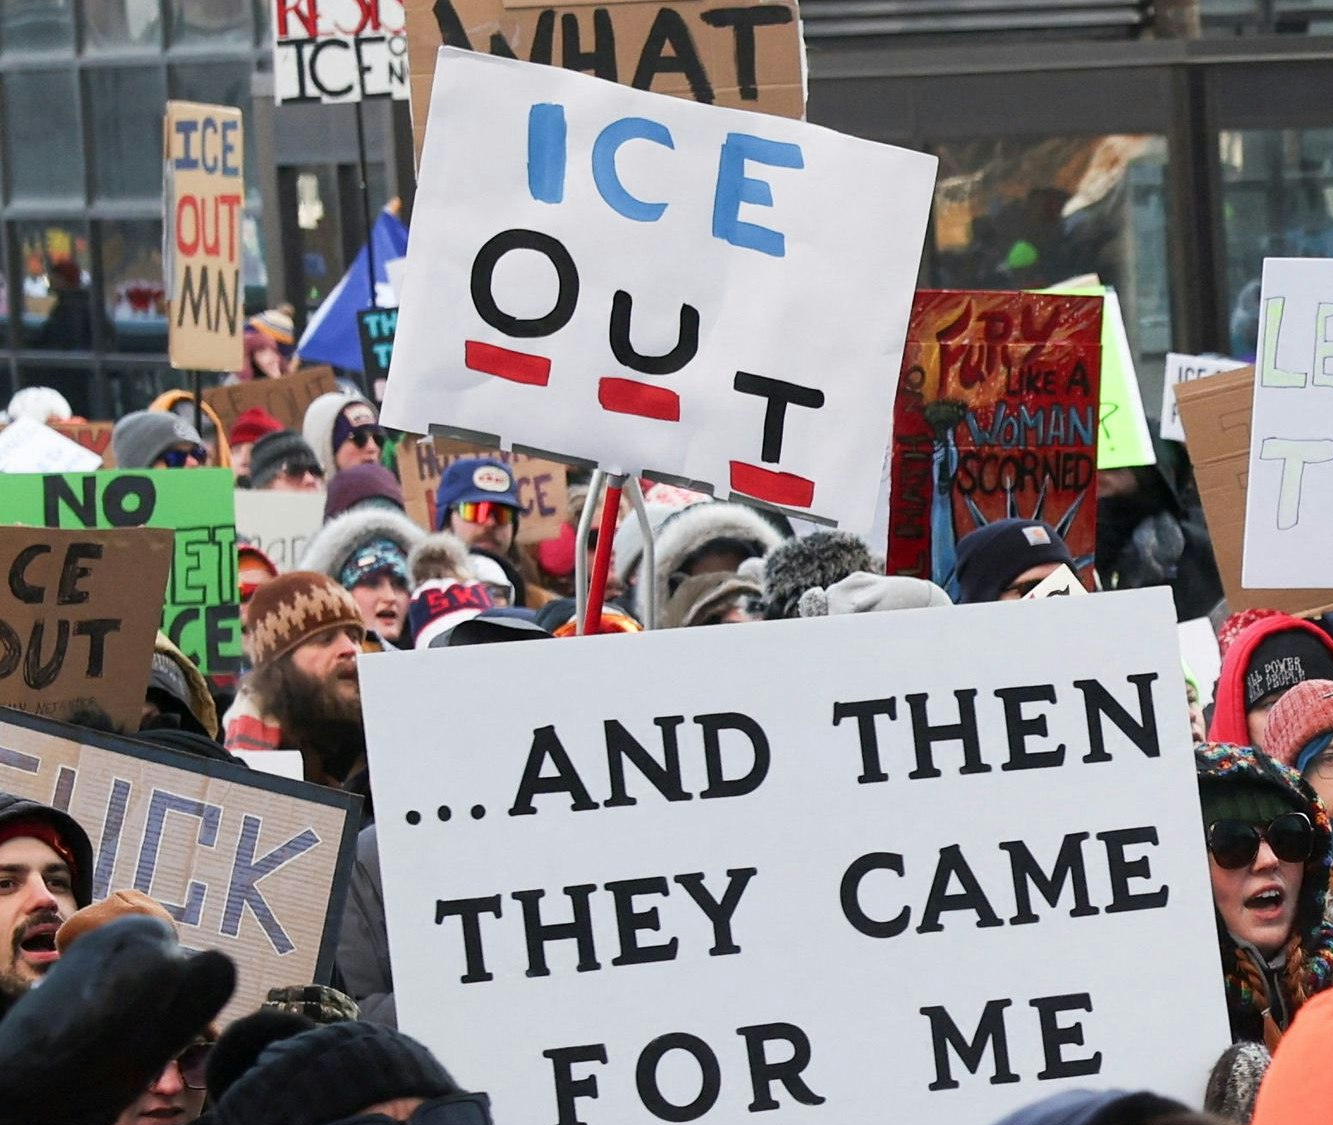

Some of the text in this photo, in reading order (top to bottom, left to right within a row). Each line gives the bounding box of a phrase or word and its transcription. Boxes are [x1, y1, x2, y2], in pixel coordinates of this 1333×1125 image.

[277, 36, 392, 104] ICE
[432, 0, 793, 102] WHAT
[175, 116, 239, 177] ICE
[527, 103, 804, 257] ICE
[176, 194, 241, 262] OUT
[177, 265, 239, 337] MN
[470, 228, 824, 463] OUT
[1006, 361, 1091, 397] LIKE A
[964, 402, 1094, 449] WOMAN
[43, 475, 156, 527] NO
[957, 451, 1093, 495] SCORNED
[405, 673, 1160, 825] ...AND THEN
[435, 826, 1170, 984] THEY CAME
[920, 993, 1103, 1091] ME
